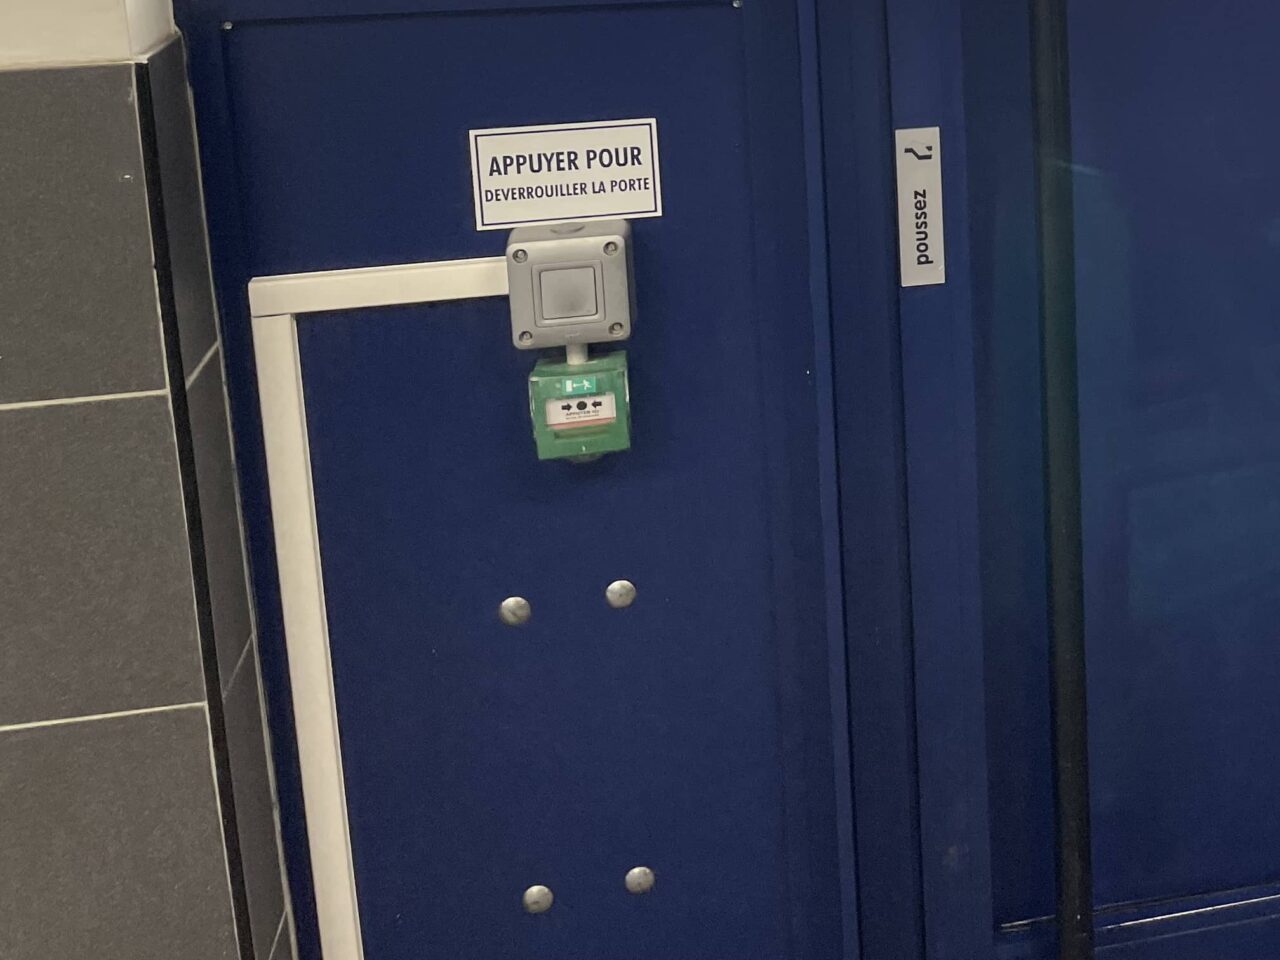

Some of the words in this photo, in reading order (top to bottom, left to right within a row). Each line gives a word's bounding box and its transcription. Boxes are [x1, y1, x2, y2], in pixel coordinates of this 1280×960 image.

[488, 150, 579, 177] APPUYER
[586, 146, 643, 169] POUR
[485, 182, 588, 202] DEVERROUILLER
[591, 180, 606, 194] LA
[610, 177, 650, 192] PORTE
[914, 189, 933, 265] poussez
